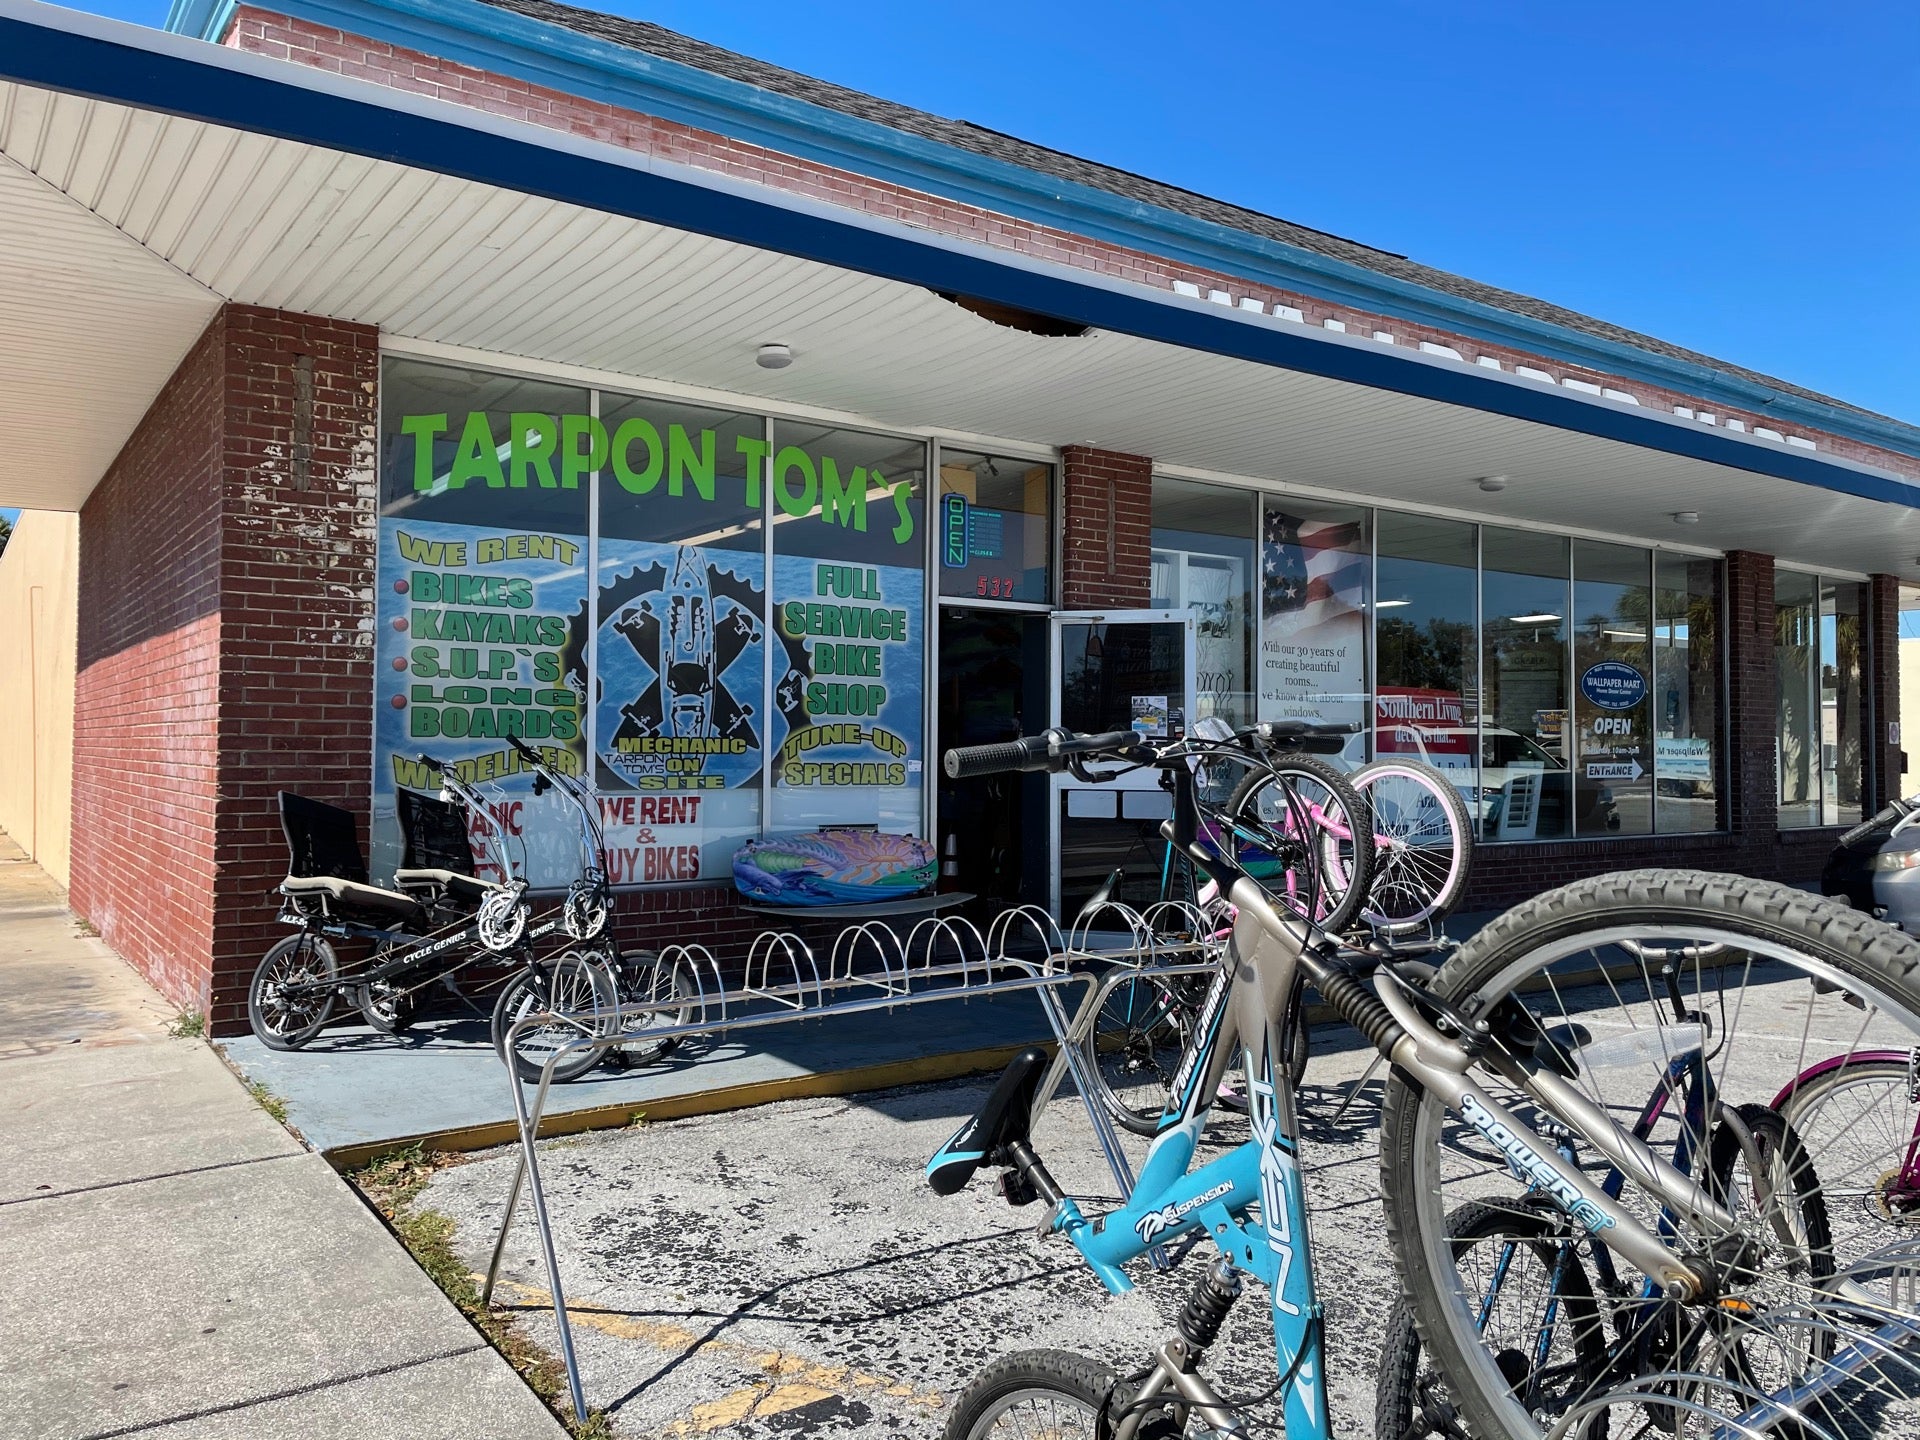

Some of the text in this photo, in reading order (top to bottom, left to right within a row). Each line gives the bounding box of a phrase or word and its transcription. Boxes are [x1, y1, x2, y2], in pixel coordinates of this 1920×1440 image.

[401, 411, 716, 501] TARPON
[949, 499, 964, 564] OPEN
[396, 530, 579, 567] WE RENT
[411, 571, 533, 609] BIKES
[817, 564, 881, 601] FULL
[411, 608, 566, 647] KAYAKS
[785, 601, 907, 641] SERVICE
[815, 642, 881, 677] BIKE
[1266, 658, 1340, 673] creating beautiful
[1281, 645, 1295, 655] our
[1297, 646, 1309, 657] 30
[1310, 648, 1334, 659] years
[1336, 646, 1346, 658] of
[411, 685, 577, 707] LONG
[1276, 688, 1296, 701] know
[1299, 693, 1304, 702] a
[1320, 691, 1344, 704] about
[1285, 677, 1318, 687] rooms...
[1587, 677, 1640, 689] WALLPAPER MART
[806, 682, 887, 716] SHOP
[1284, 705, 1324, 718] windows.
[1379, 695, 1464, 728] Southern Living
[410, 707, 578, 740] BOARDS
[1594, 717, 1632, 735] OPEN
[617, 737, 747, 754] MECHANIC
[785, 723, 907, 760] TUNE-UP
[392, 754, 445, 790] WE
[604, 754, 664, 764] TARPON
[623, 765, 664, 774] TOM'S
[665, 757, 700, 773] ON
[785, 762, 906, 786] SPECIALS
[1589, 766, 1633, 776] ENTRANCE
[639, 775, 725, 790] SITE
[598, 796, 702, 825] WE RENT
[636, 828, 657, 844] &
[644, 845, 700, 881] BIKES
[403, 930, 467, 964] CYCLE GENIUS
[1246, 1048, 1300, 1317] NEXT
[1165, 1179, 1235, 1222] SUSPENSION
